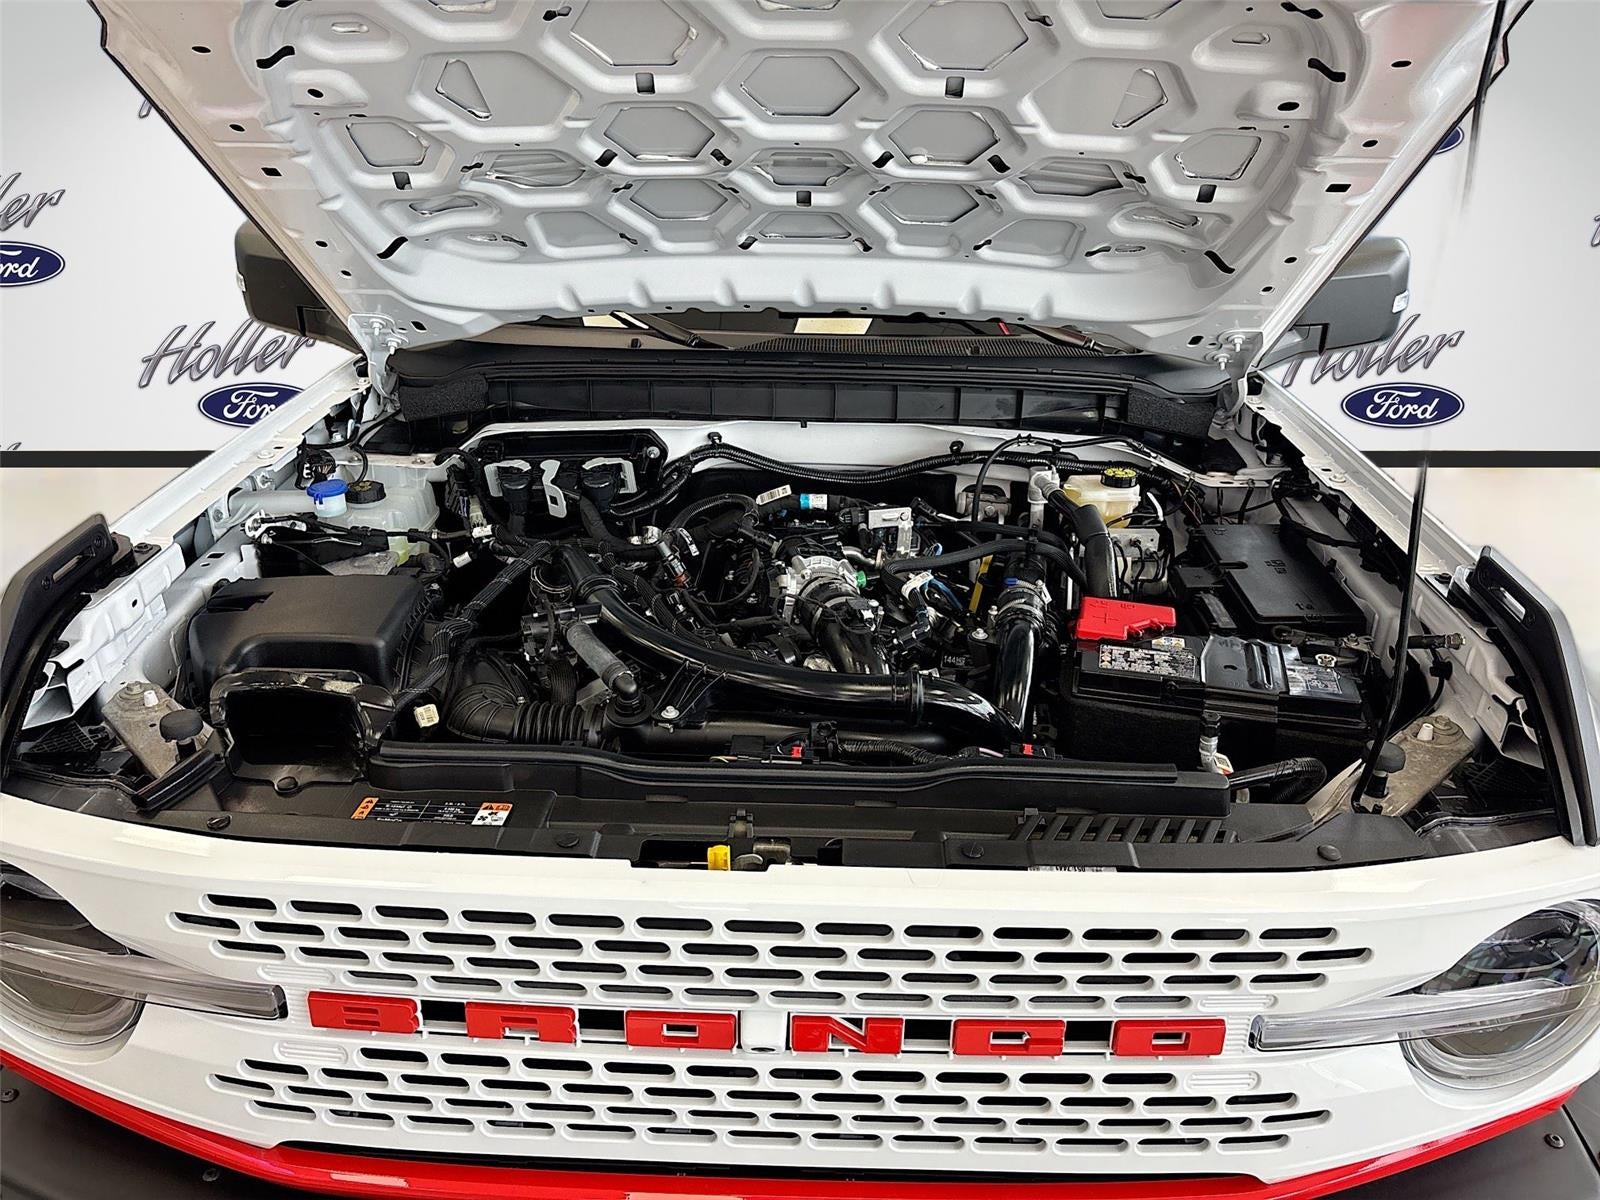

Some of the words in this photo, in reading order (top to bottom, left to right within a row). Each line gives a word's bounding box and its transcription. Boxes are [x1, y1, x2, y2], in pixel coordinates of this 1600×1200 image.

[138, 318, 317, 389] Holler
[223, 390, 279, 419] For
[1365, 389, 1440, 419] Ford
[307, 990, 1227, 1058] BRONCO
